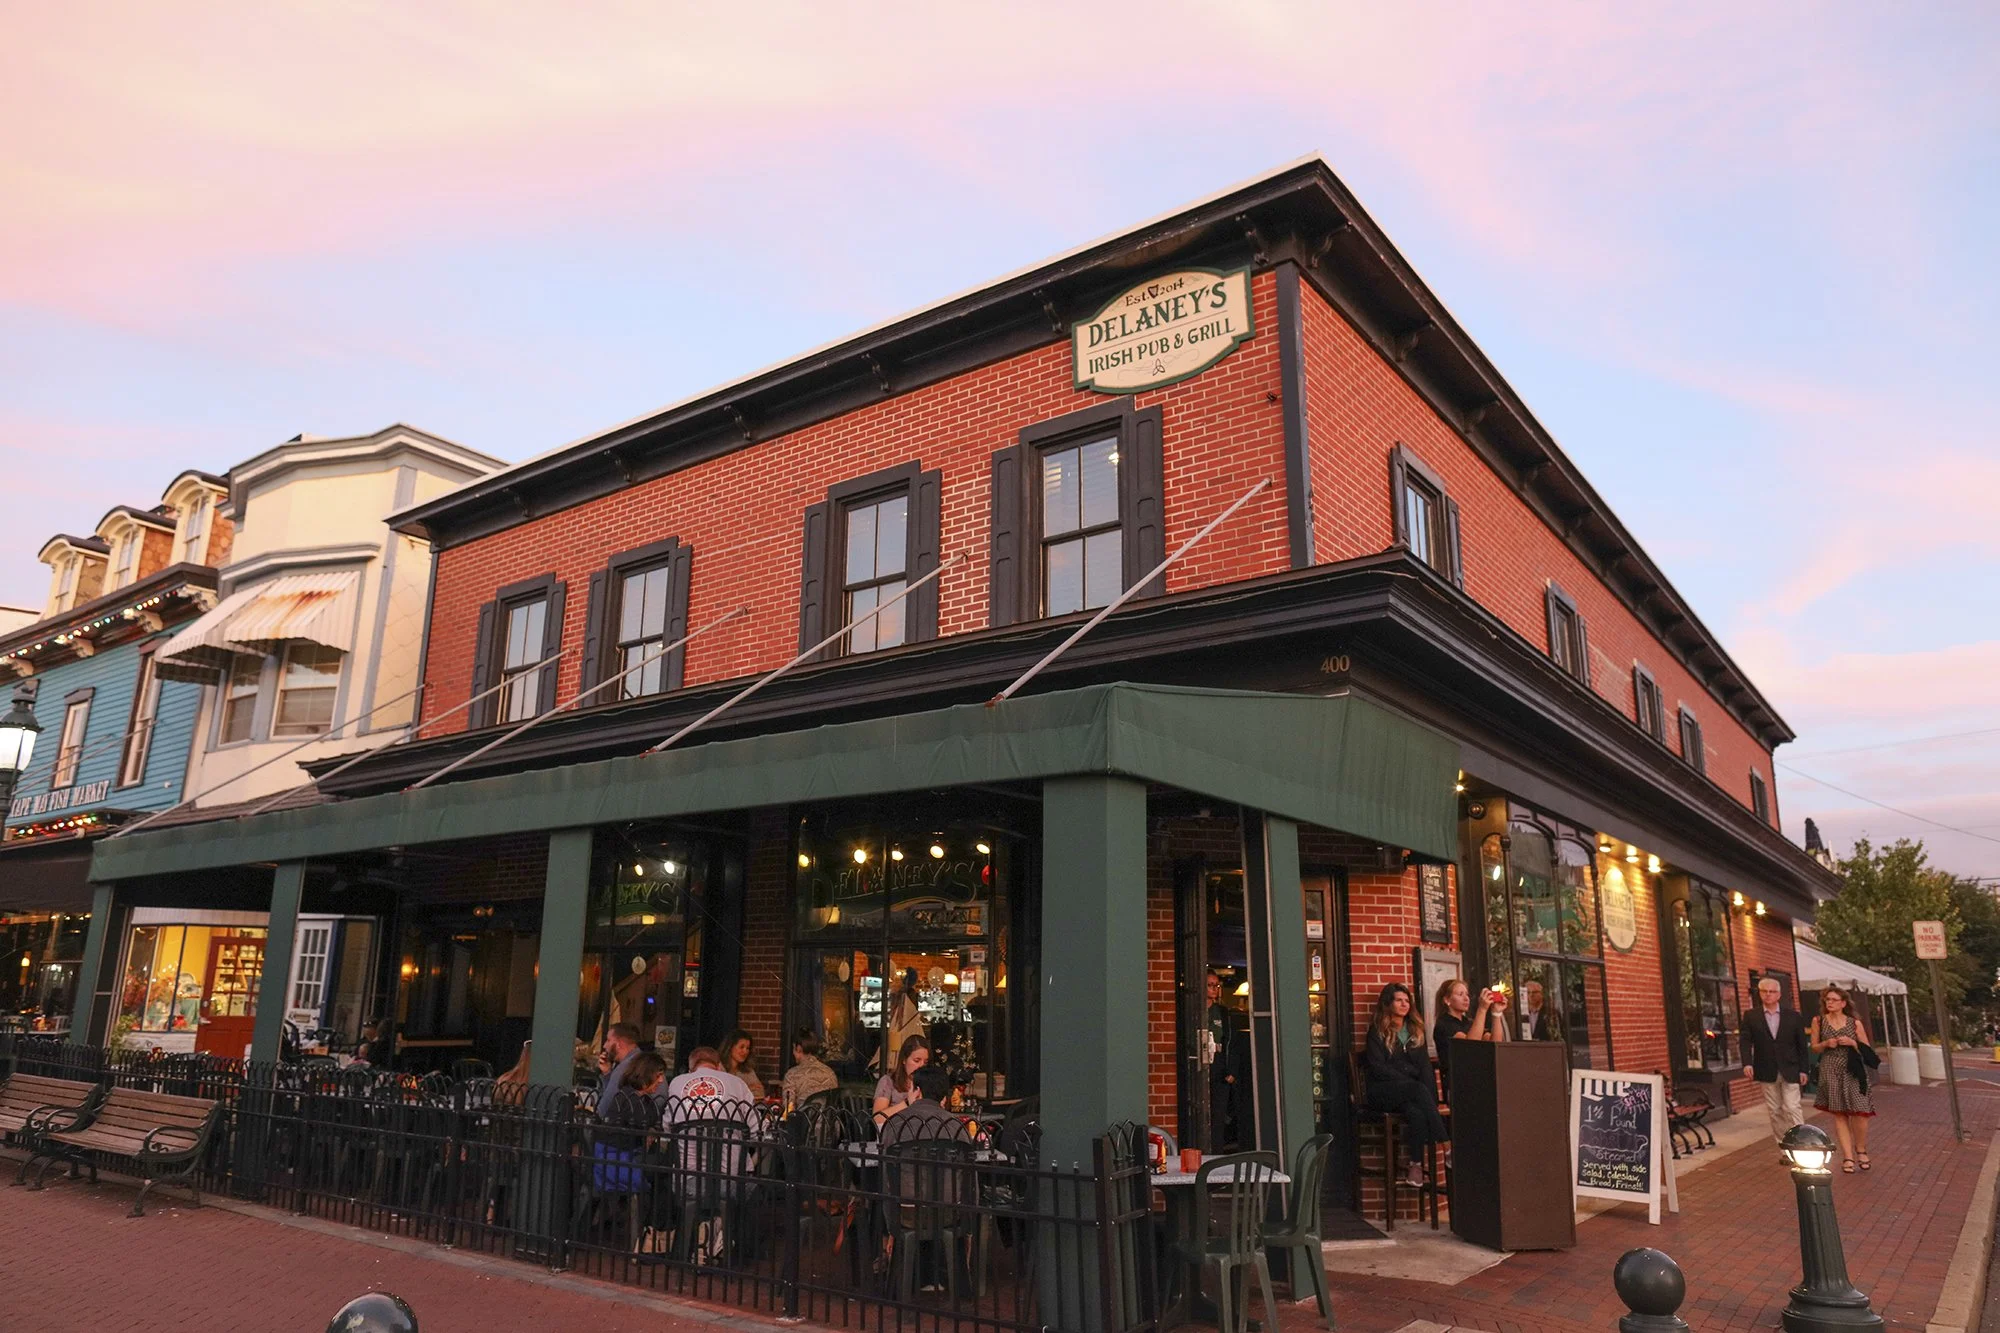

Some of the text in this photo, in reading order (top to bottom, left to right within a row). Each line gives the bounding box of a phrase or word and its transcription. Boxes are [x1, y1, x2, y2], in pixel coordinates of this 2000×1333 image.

[1125, 277, 1185, 307] Est. 2014
[1088, 281, 1227, 348] DELANEY'S
[1089, 318, 1236, 375] IRISH PUB & GRILL
[1320, 655, 1350, 673] 400
[10, 780, 110, 818] CAPE MAY FISH MARKET
[1922, 926, 1934, 934] NO
[1582, 1159, 1647, 1174] Served with side
